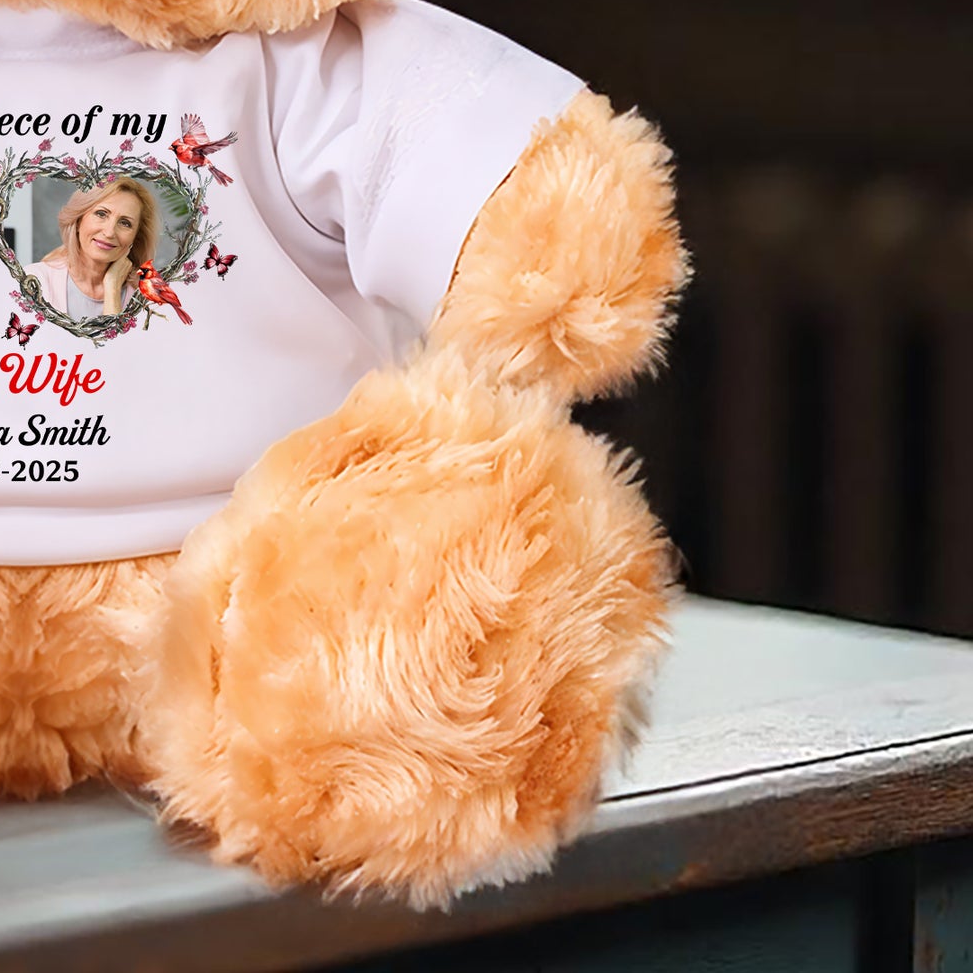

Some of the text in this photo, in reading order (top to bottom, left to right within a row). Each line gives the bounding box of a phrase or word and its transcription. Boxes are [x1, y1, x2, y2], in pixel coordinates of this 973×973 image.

[60, 104, 104, 144] of
[109, 113, 168, 144] my
[0, 352, 106, 407] Wife
[17, 413, 111, 447] Smith
